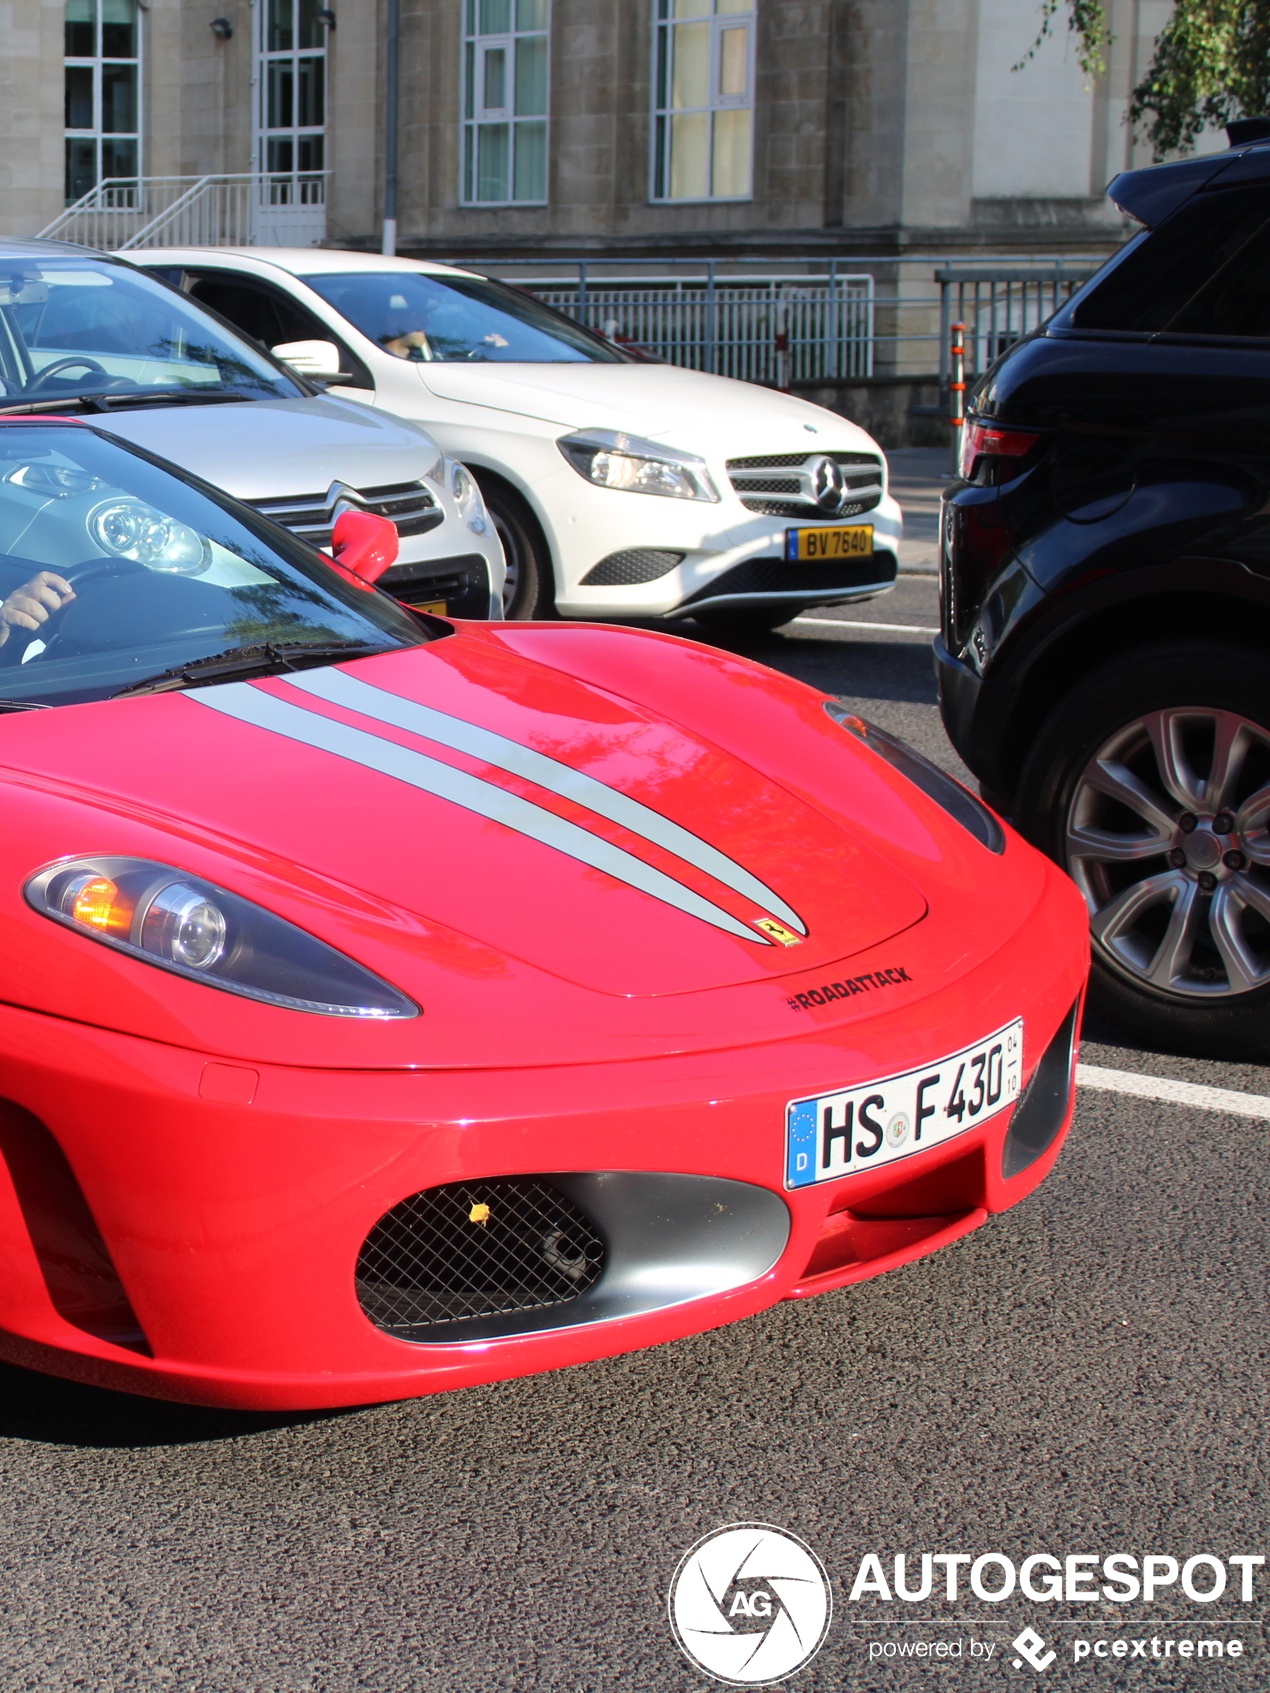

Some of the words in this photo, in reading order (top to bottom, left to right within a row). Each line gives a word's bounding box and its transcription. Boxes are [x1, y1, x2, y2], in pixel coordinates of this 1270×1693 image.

[807, 531, 828, 556] BV
[833, 529, 867, 554] 7640
[785, 967, 913, 1012] #ROADATTACK
[822, 1094, 884, 1169] HS
[914, 1073, 940, 1141] F
[946, 1043, 1003, 1123] 430
[796, 1152, 808, 1171] D
